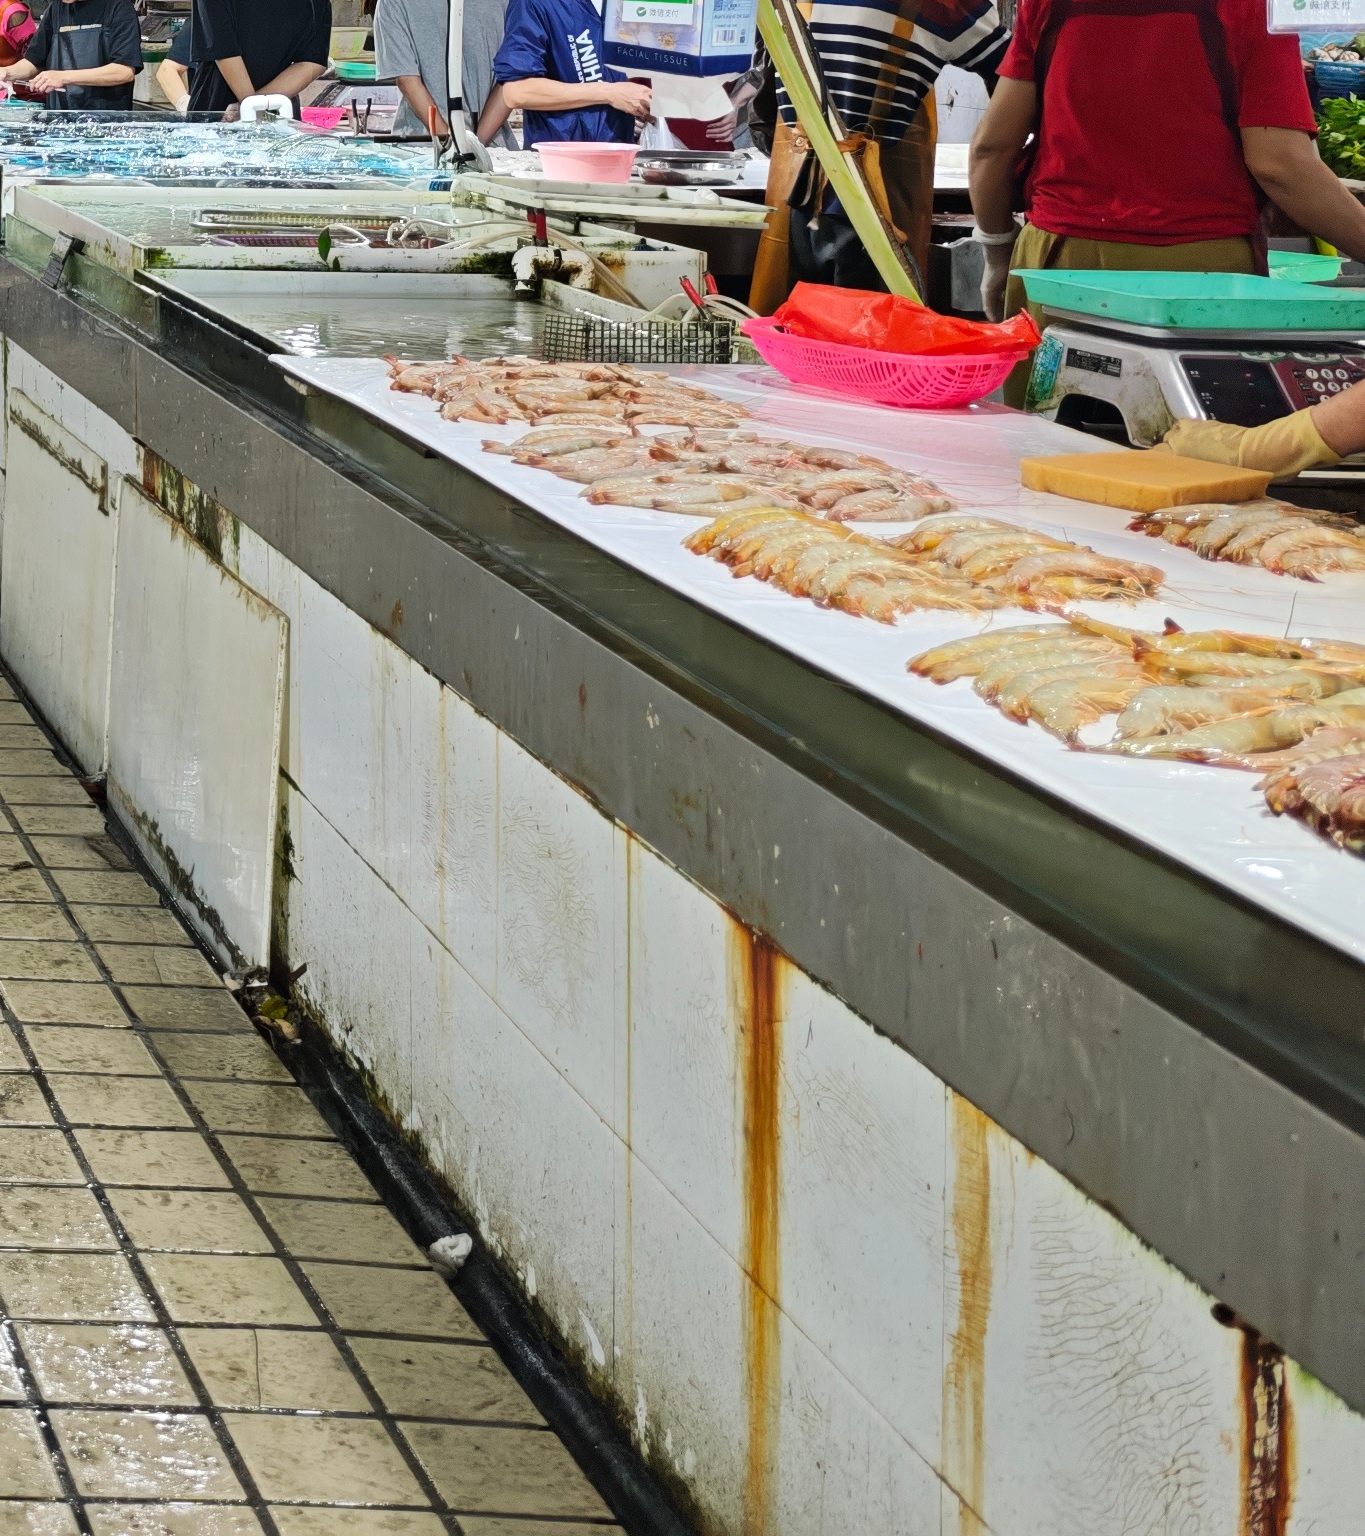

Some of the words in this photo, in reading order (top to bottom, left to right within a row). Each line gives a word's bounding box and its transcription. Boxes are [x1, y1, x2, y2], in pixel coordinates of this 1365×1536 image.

[648, 8, 679, 19] 微信支付
[575, 28, 603, 83] HINA
[617, 46, 650, 61] FACIAL
[653, 51, 689, 67] TISSUE
